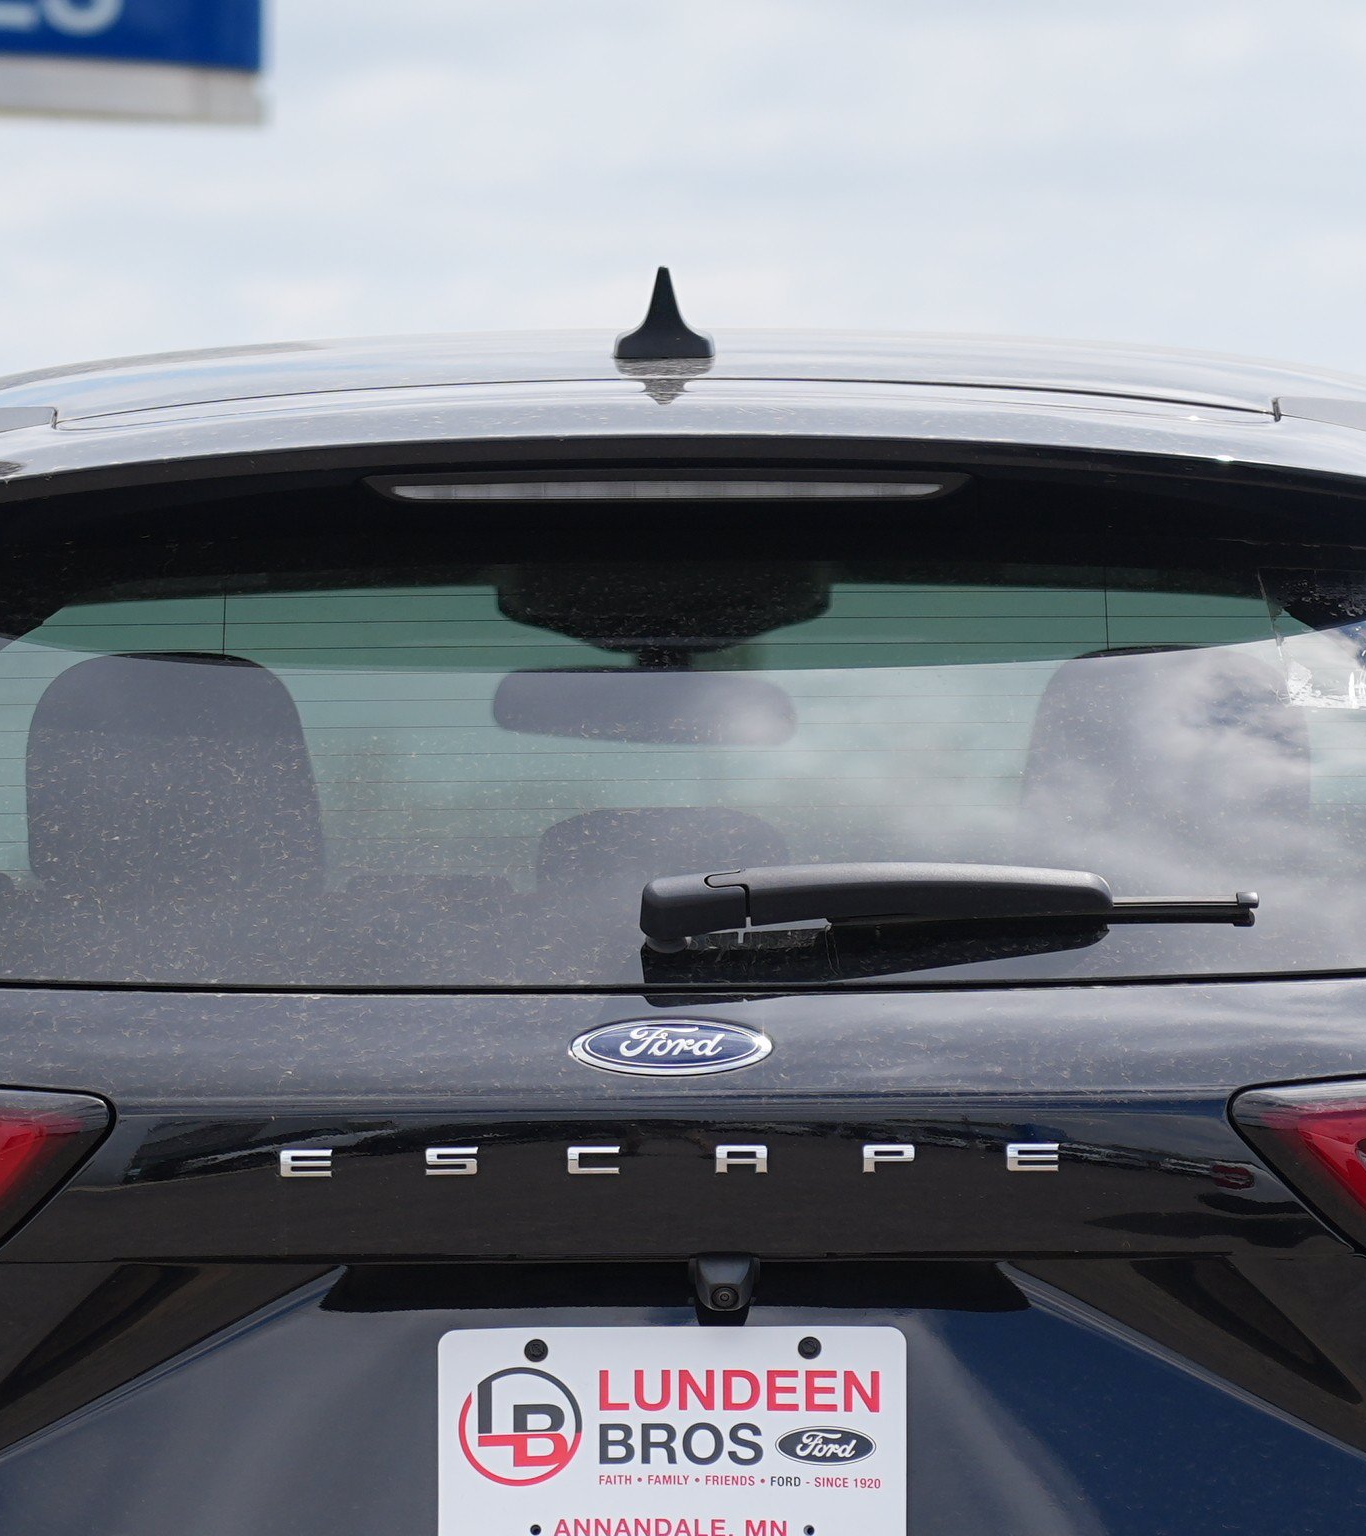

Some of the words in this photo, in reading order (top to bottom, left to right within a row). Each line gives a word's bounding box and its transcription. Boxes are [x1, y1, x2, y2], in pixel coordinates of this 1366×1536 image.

[619, 1026, 726, 1057] Ford
[278, 1143, 1061, 1178] ESCAPE
[598, 1369, 880, 1413] LUNDEEN
[598, 1422, 764, 1466] BROS
[795, 1431, 857, 1458] Ford
[598, 1474, 632, 1486] FAITH
[647, 1474, 690, 1486] FAMILY
[705, 1475, 755, 1487] FRIENDS
[770, 1476, 801, 1487] FORD
[814, 1476, 849, 1488] SINCE
[854, 1478, 881, 1489] 1920
